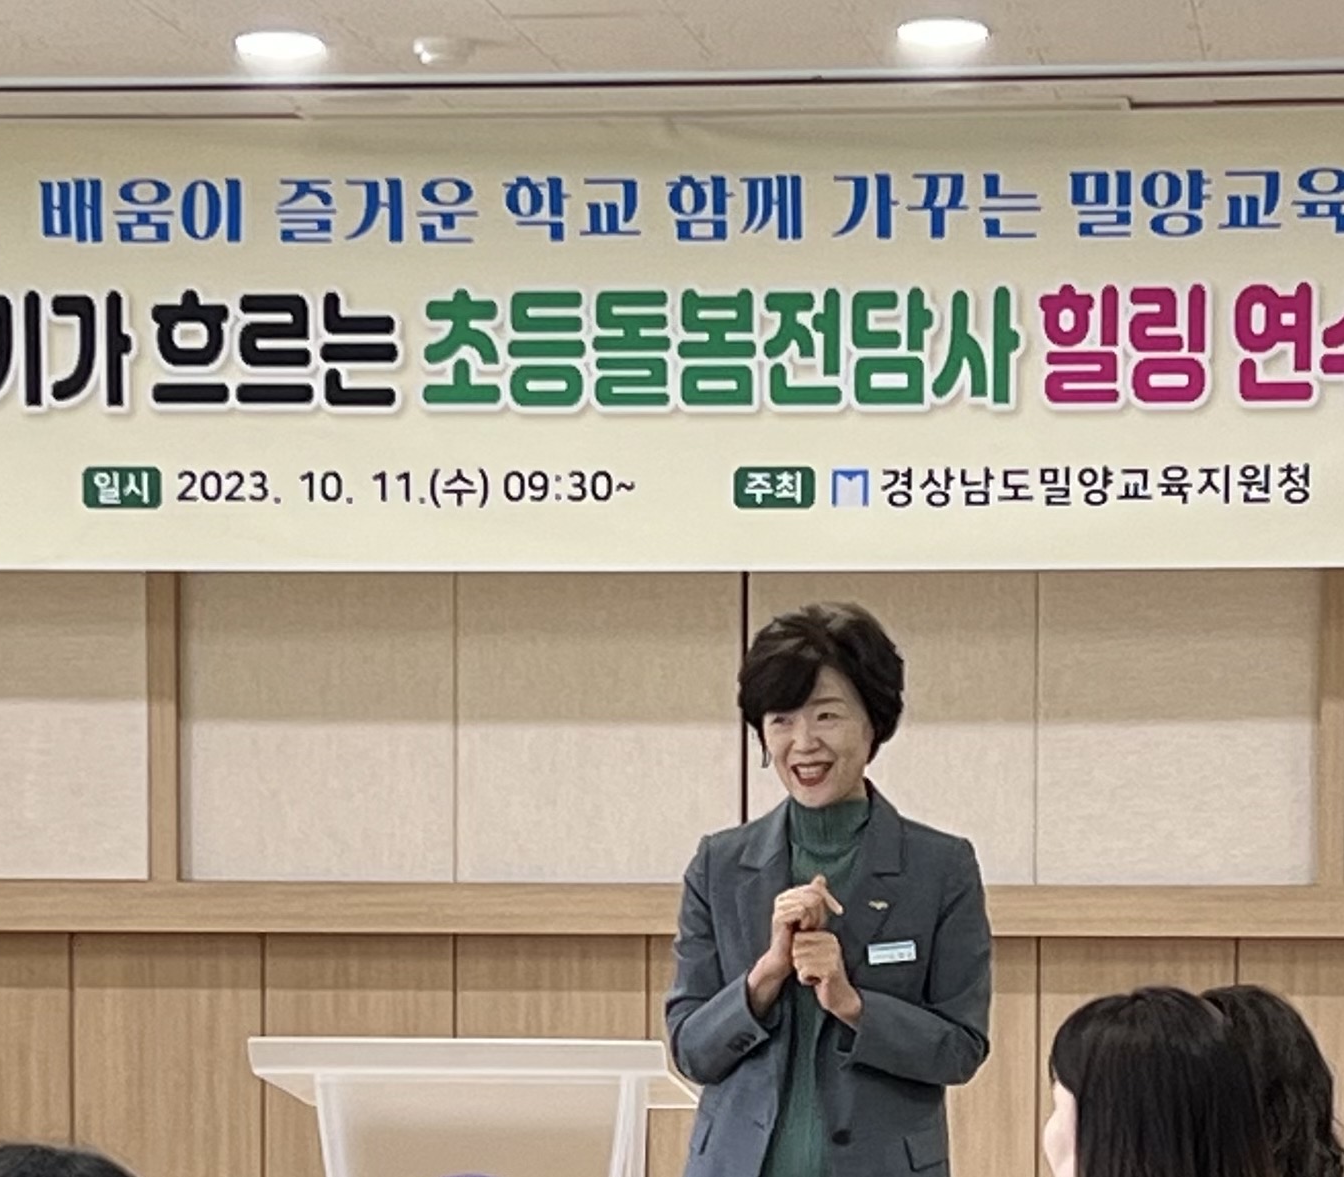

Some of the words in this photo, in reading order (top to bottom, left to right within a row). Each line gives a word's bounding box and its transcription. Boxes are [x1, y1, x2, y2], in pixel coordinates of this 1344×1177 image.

[39, 177, 242, 243] 배움이
[276, 177, 478, 243] 즐거운
[502, 176, 642, 242] 학교
[666, 174, 802, 241] 함께
[833, 173, 1041, 240] 가꾸는
[152, 290, 398, 406] 흐르는
[423, 287, 1021, 406] 초등돌봄전담사
[1040, 284, 1205, 403] 힐링
[92, 469, 150, 504] 일시
[177, 470, 281, 504] 2023.
[299, 470, 353, 504] 10.
[372, 468, 489, 508] 11.(수)
[503, 470, 635, 503] 09:30~
[743, 470, 803, 504] 주최
[881, 463, 1310, 507] 경상남도밀양교육지원청
